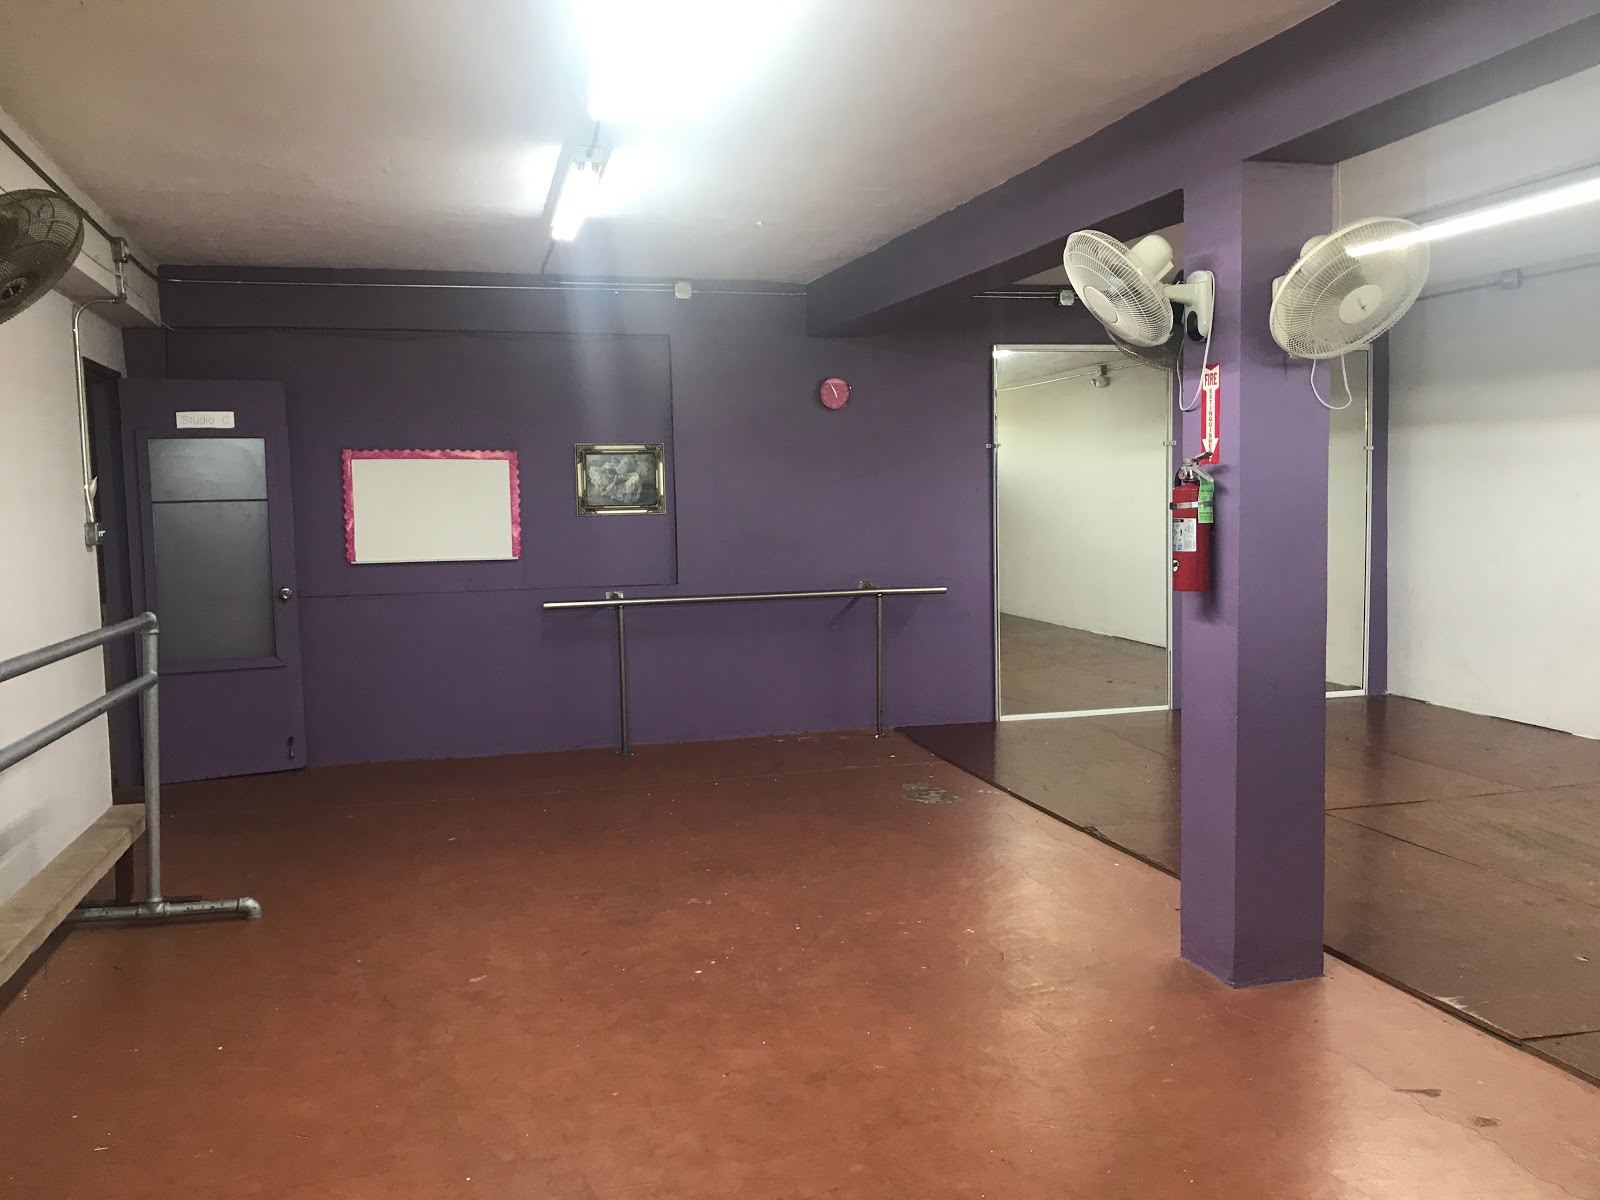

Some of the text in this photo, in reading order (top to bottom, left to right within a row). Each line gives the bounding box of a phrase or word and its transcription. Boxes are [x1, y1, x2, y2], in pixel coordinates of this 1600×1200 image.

[1204, 372, 1218, 387] FIRE
[181, 415, 230, 425] Studio C
